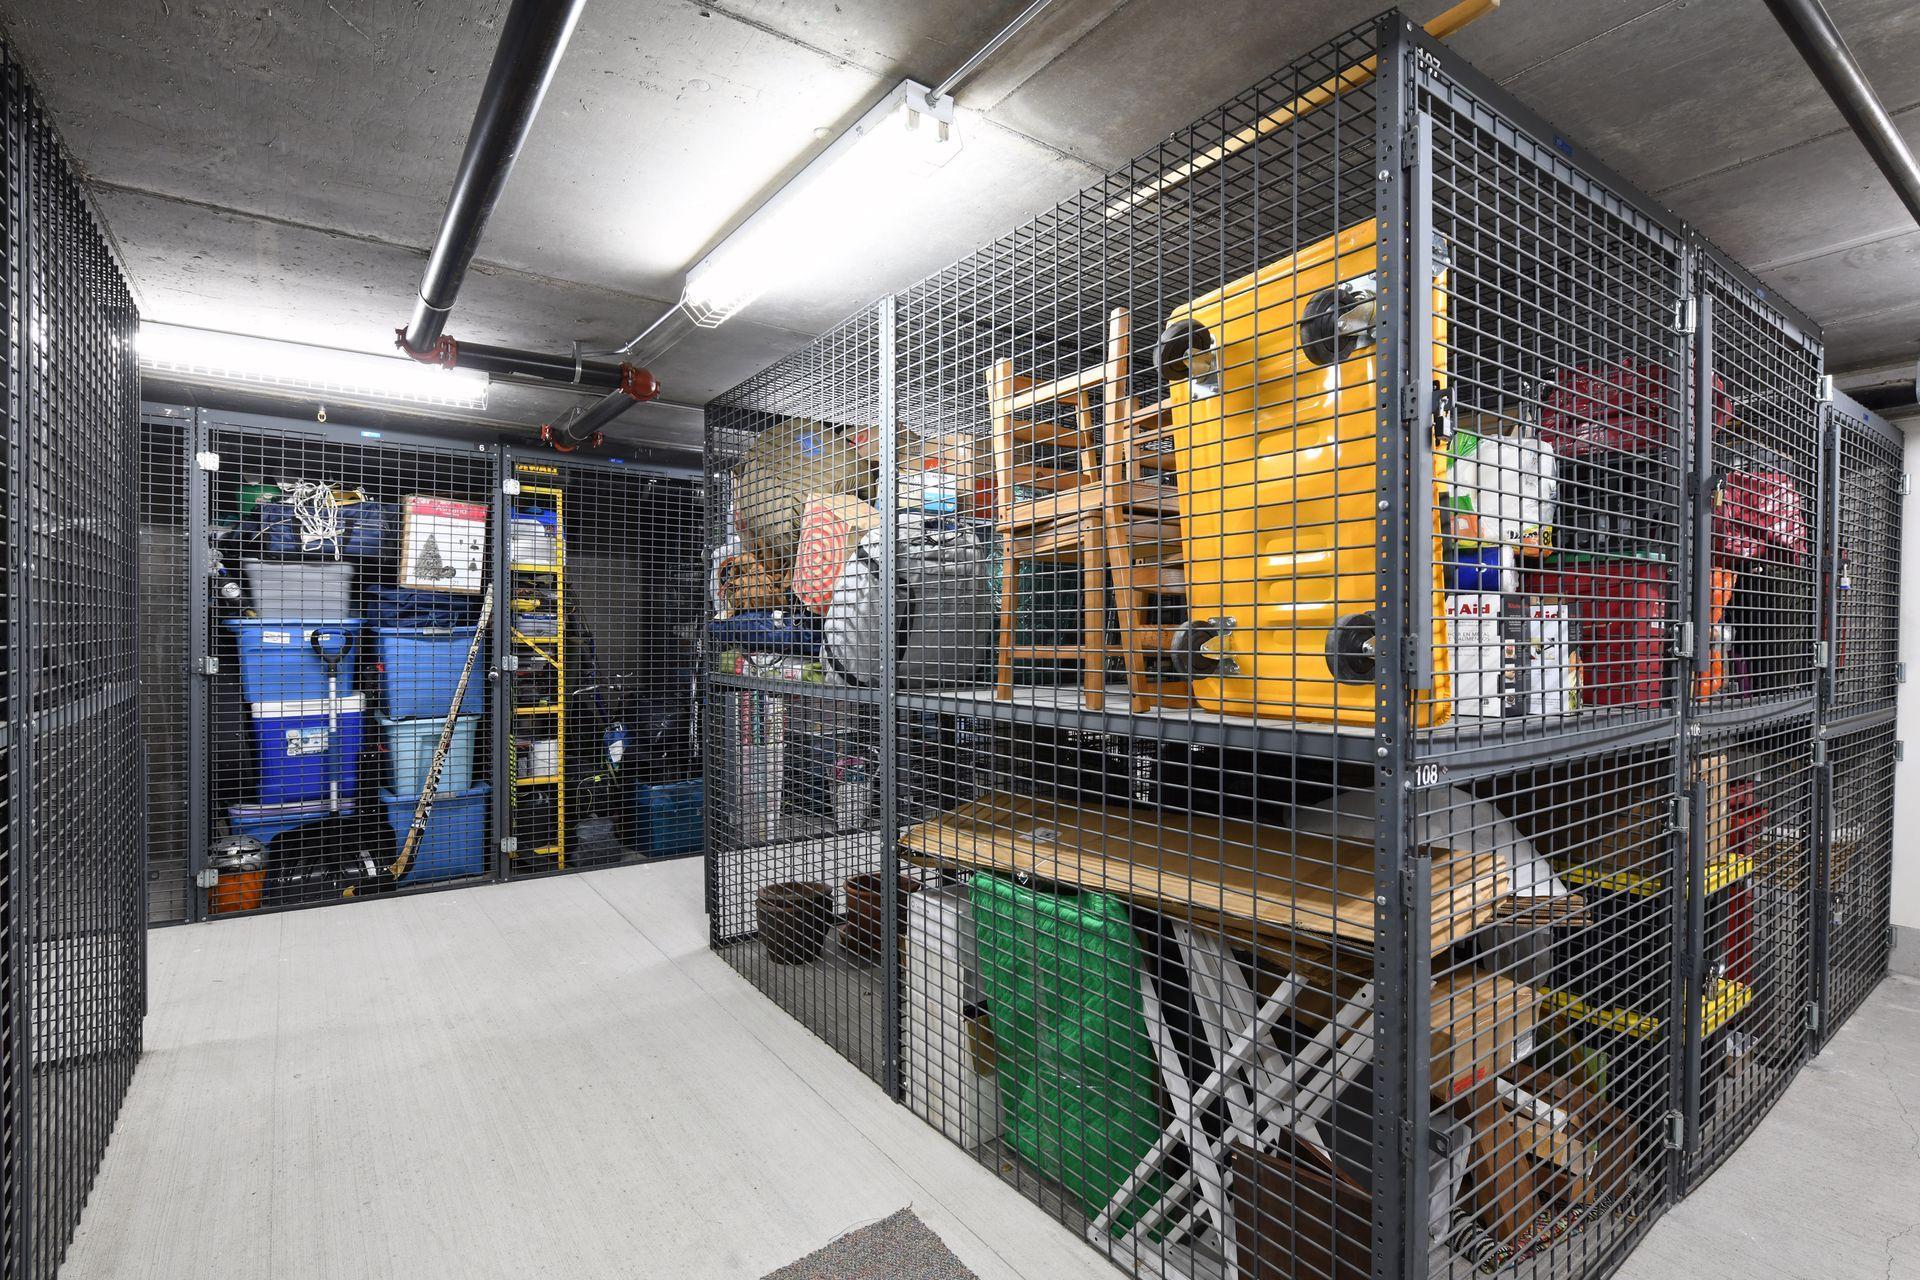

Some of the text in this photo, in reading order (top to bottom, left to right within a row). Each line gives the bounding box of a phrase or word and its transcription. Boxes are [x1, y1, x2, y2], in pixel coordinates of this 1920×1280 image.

[1416, 46, 1441, 78] 107
[479, 444, 485, 452] 6
[1415, 764, 1438, 786] 108
